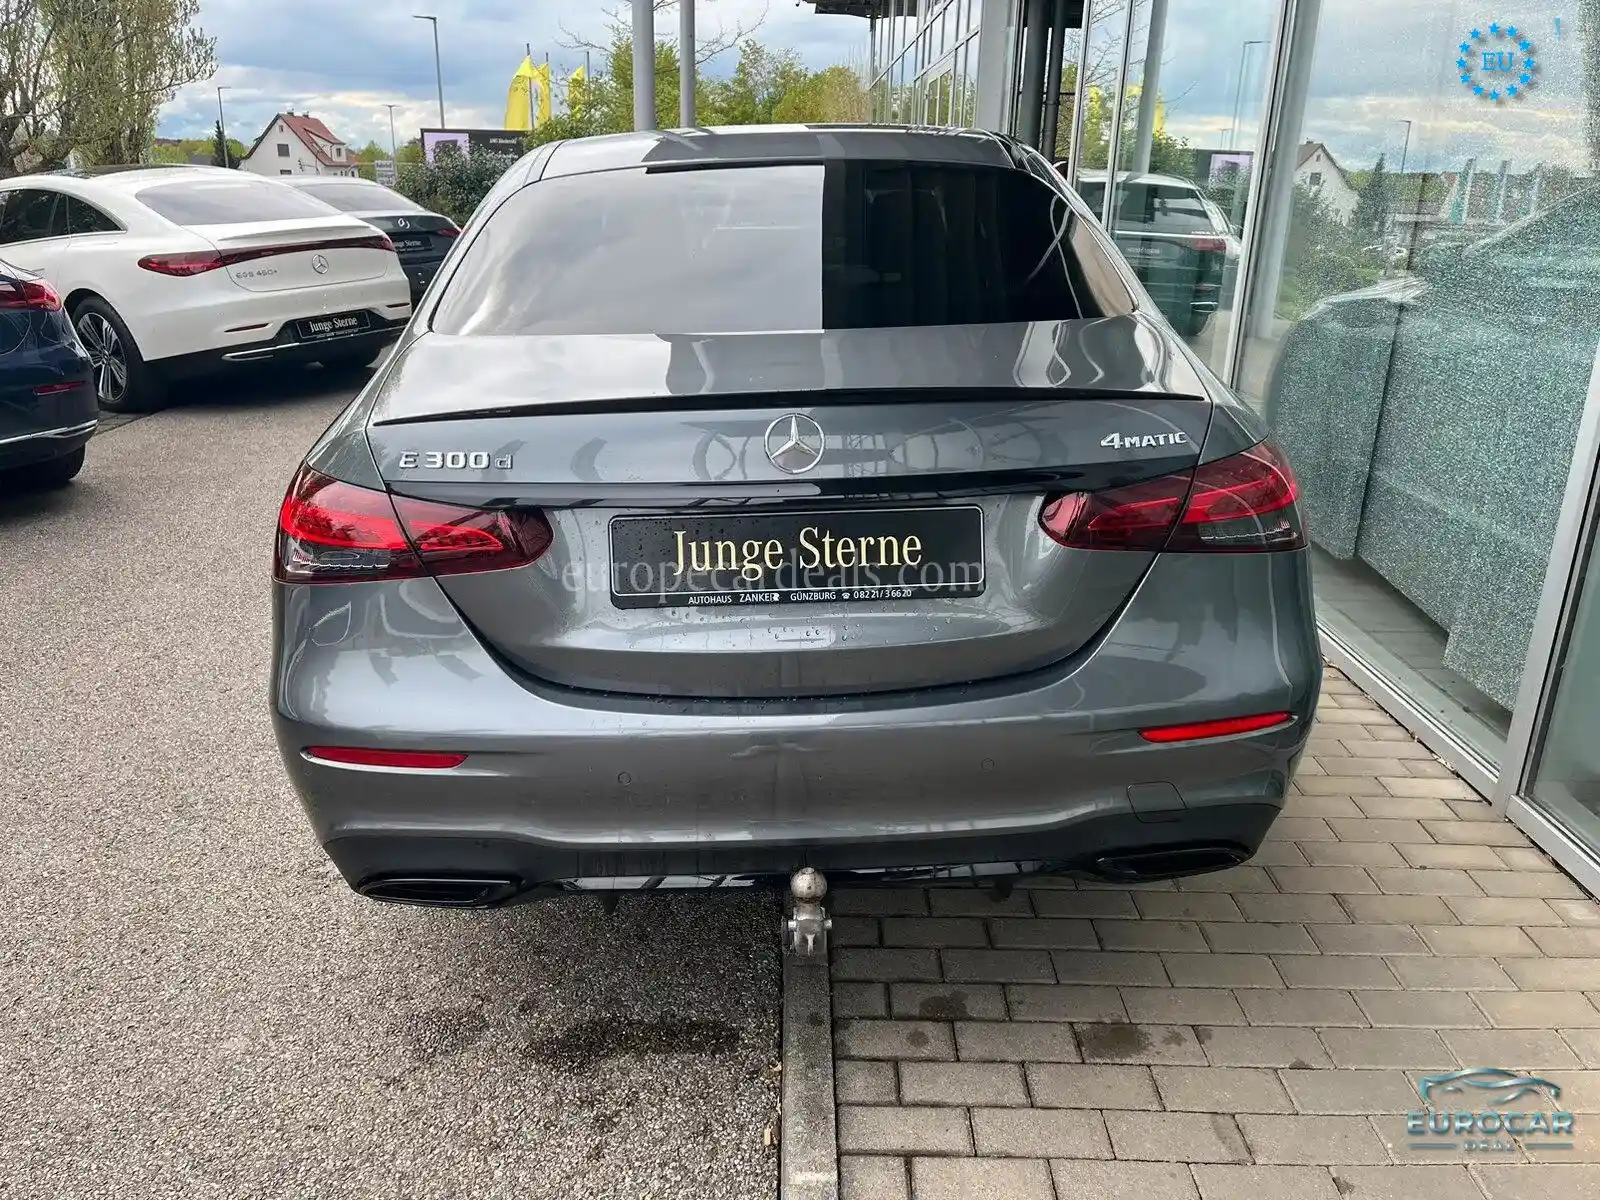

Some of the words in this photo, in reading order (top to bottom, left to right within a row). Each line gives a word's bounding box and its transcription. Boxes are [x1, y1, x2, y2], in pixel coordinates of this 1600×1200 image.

[309, 321, 333, 333] Junge
[333, 317, 358, 328] Sterne
[1100, 432, 1188, 450] 4MATIC
[400, 451, 419, 469] E
[424, 451, 489, 469] 300
[673, 530, 783, 581] Junge
[799, 526, 922, 570] Sterne
[688, 594, 732, 605] AUTOHAUS
[790, 590, 836, 601] GÜNZBURG
